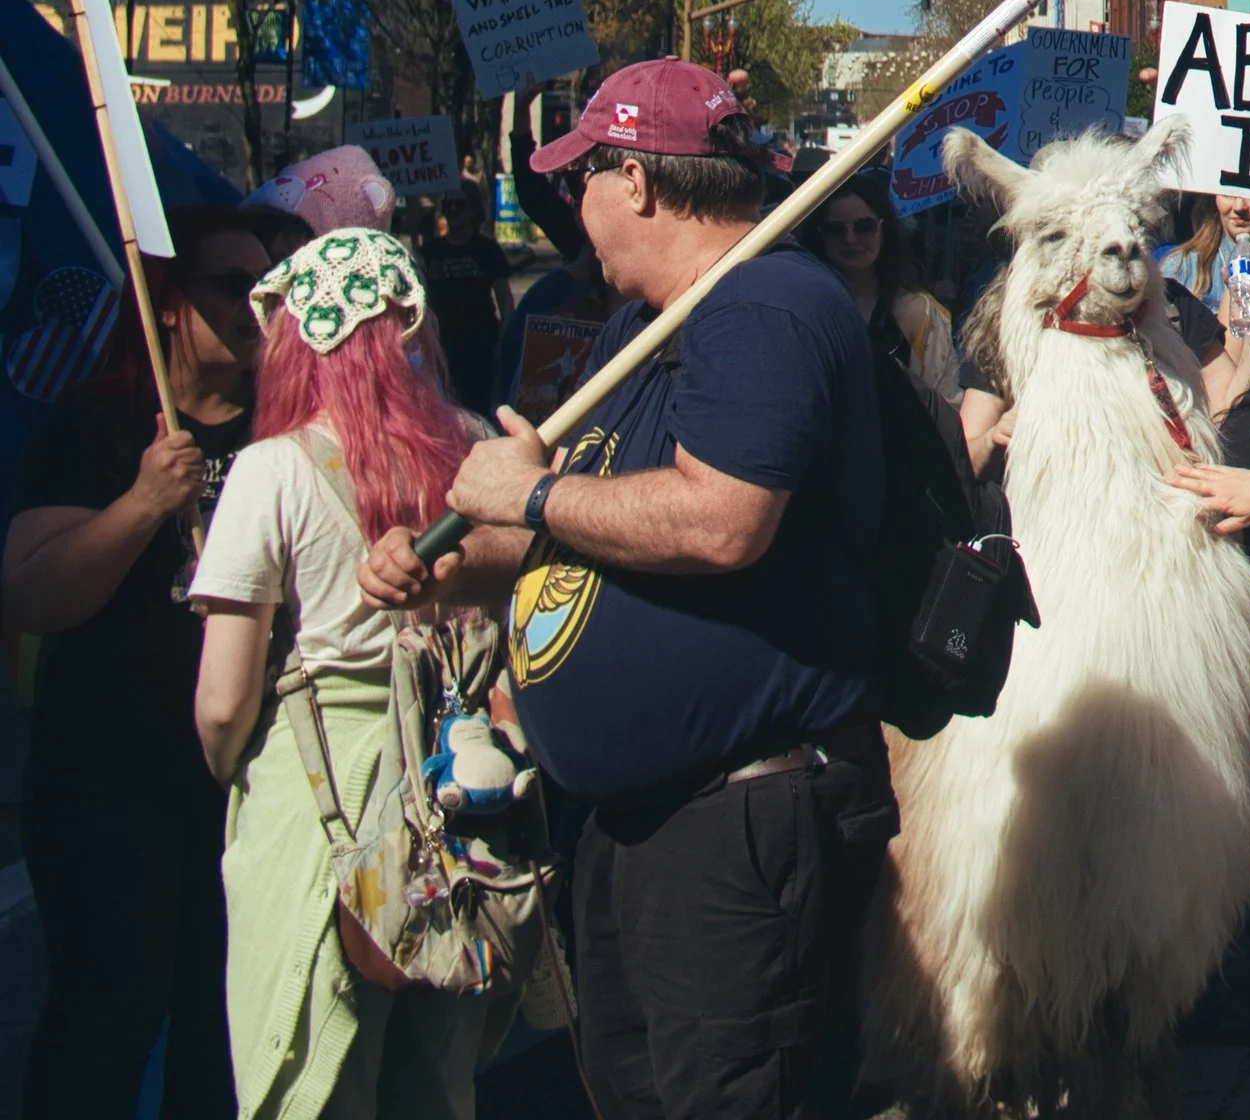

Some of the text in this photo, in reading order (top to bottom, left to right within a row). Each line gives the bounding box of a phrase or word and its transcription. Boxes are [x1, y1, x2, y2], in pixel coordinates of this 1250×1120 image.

[467, 19, 498, 38] AND
[500, 3, 540, 28] SMELL
[481, 20, 584, 62] CORRUPTION
[1031, 30, 1131, 60] GOVERNMENT
[988, 54, 1014, 77] TO
[1053, 56, 1100, 80] FOR
[164, 84, 287, 105] BURNSDE
[1031, 80, 1095, 111] People
[924, 95, 989, 133] STOP
[370, 140, 432, 170] LOVE
